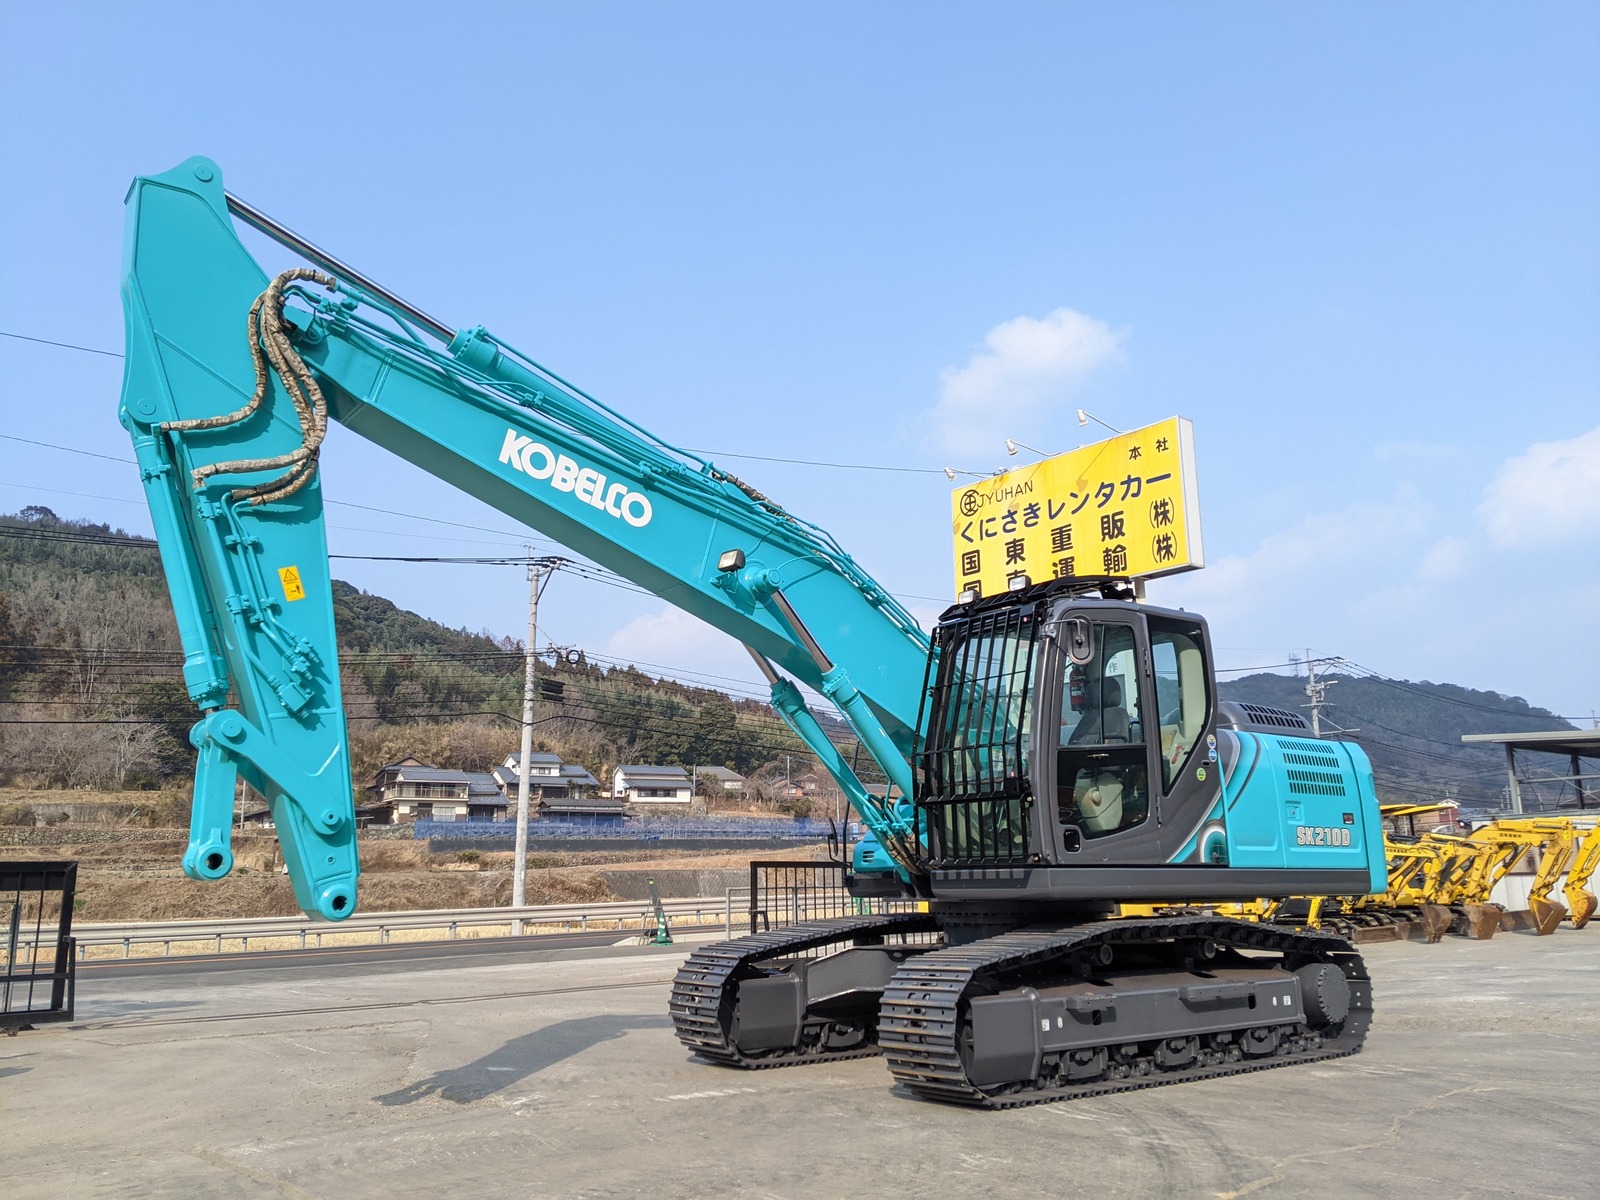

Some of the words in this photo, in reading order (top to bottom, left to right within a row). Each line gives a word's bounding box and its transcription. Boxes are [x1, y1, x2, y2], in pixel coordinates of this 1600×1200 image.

[1129, 437, 1169, 460] 本社
[499, 428, 652, 527] KOBELCO
[961, 473, 1171, 543] くにさきレンタカー
[977, 480, 1033, 508] JYUHAN
[1296, 826, 1351, 847] SK210D
